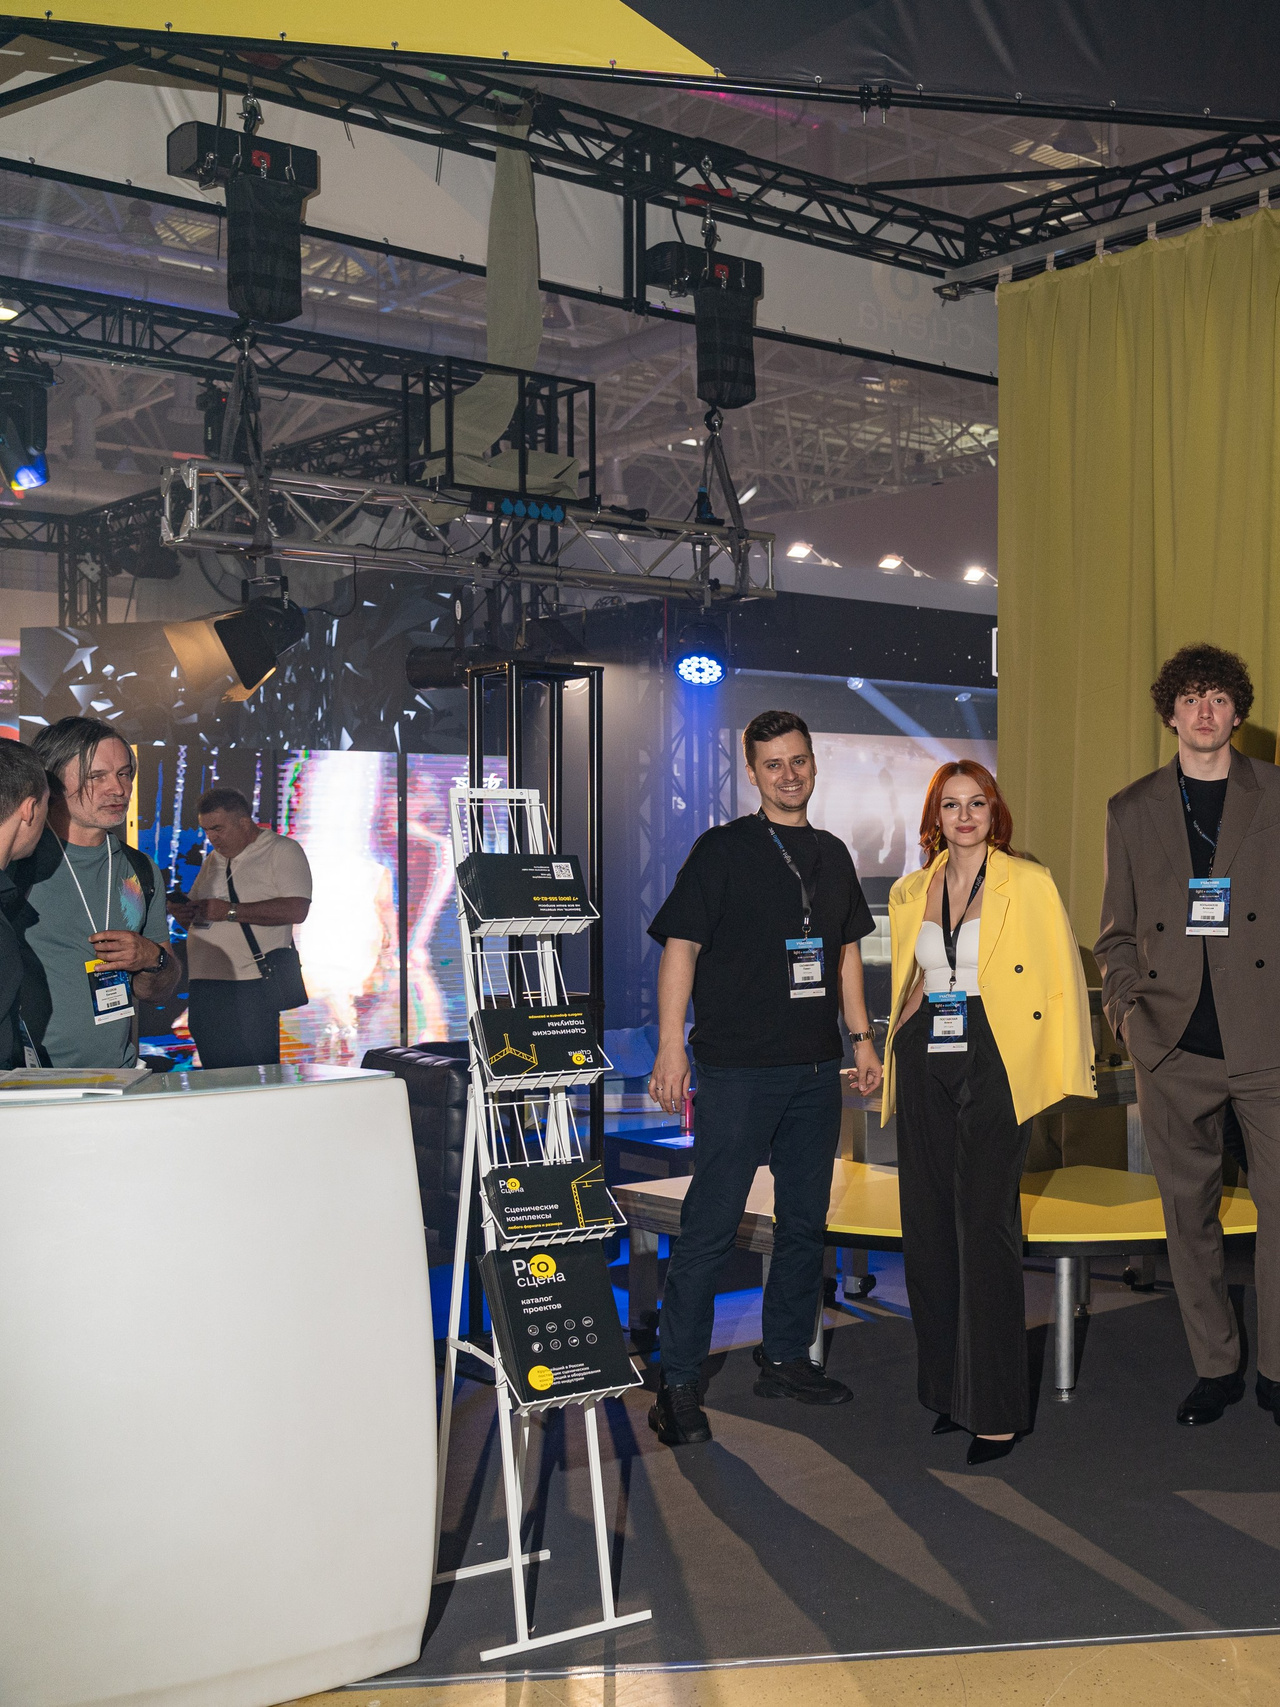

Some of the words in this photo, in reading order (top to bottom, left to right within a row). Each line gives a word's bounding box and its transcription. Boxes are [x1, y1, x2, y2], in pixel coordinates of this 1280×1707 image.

[547, 1019, 585, 1027] подиумы
[532, 1027, 587, 1036] Сценические
[504, 1203, 559, 1214] Сценические
[506, 1213, 552, 1222] комплексы
[512, 1259, 549, 1277] Pro
[517, 1272, 566, 1288] сцена
[521, 1295, 553, 1305] каталог
[523, 1303, 562, 1315] проектов
